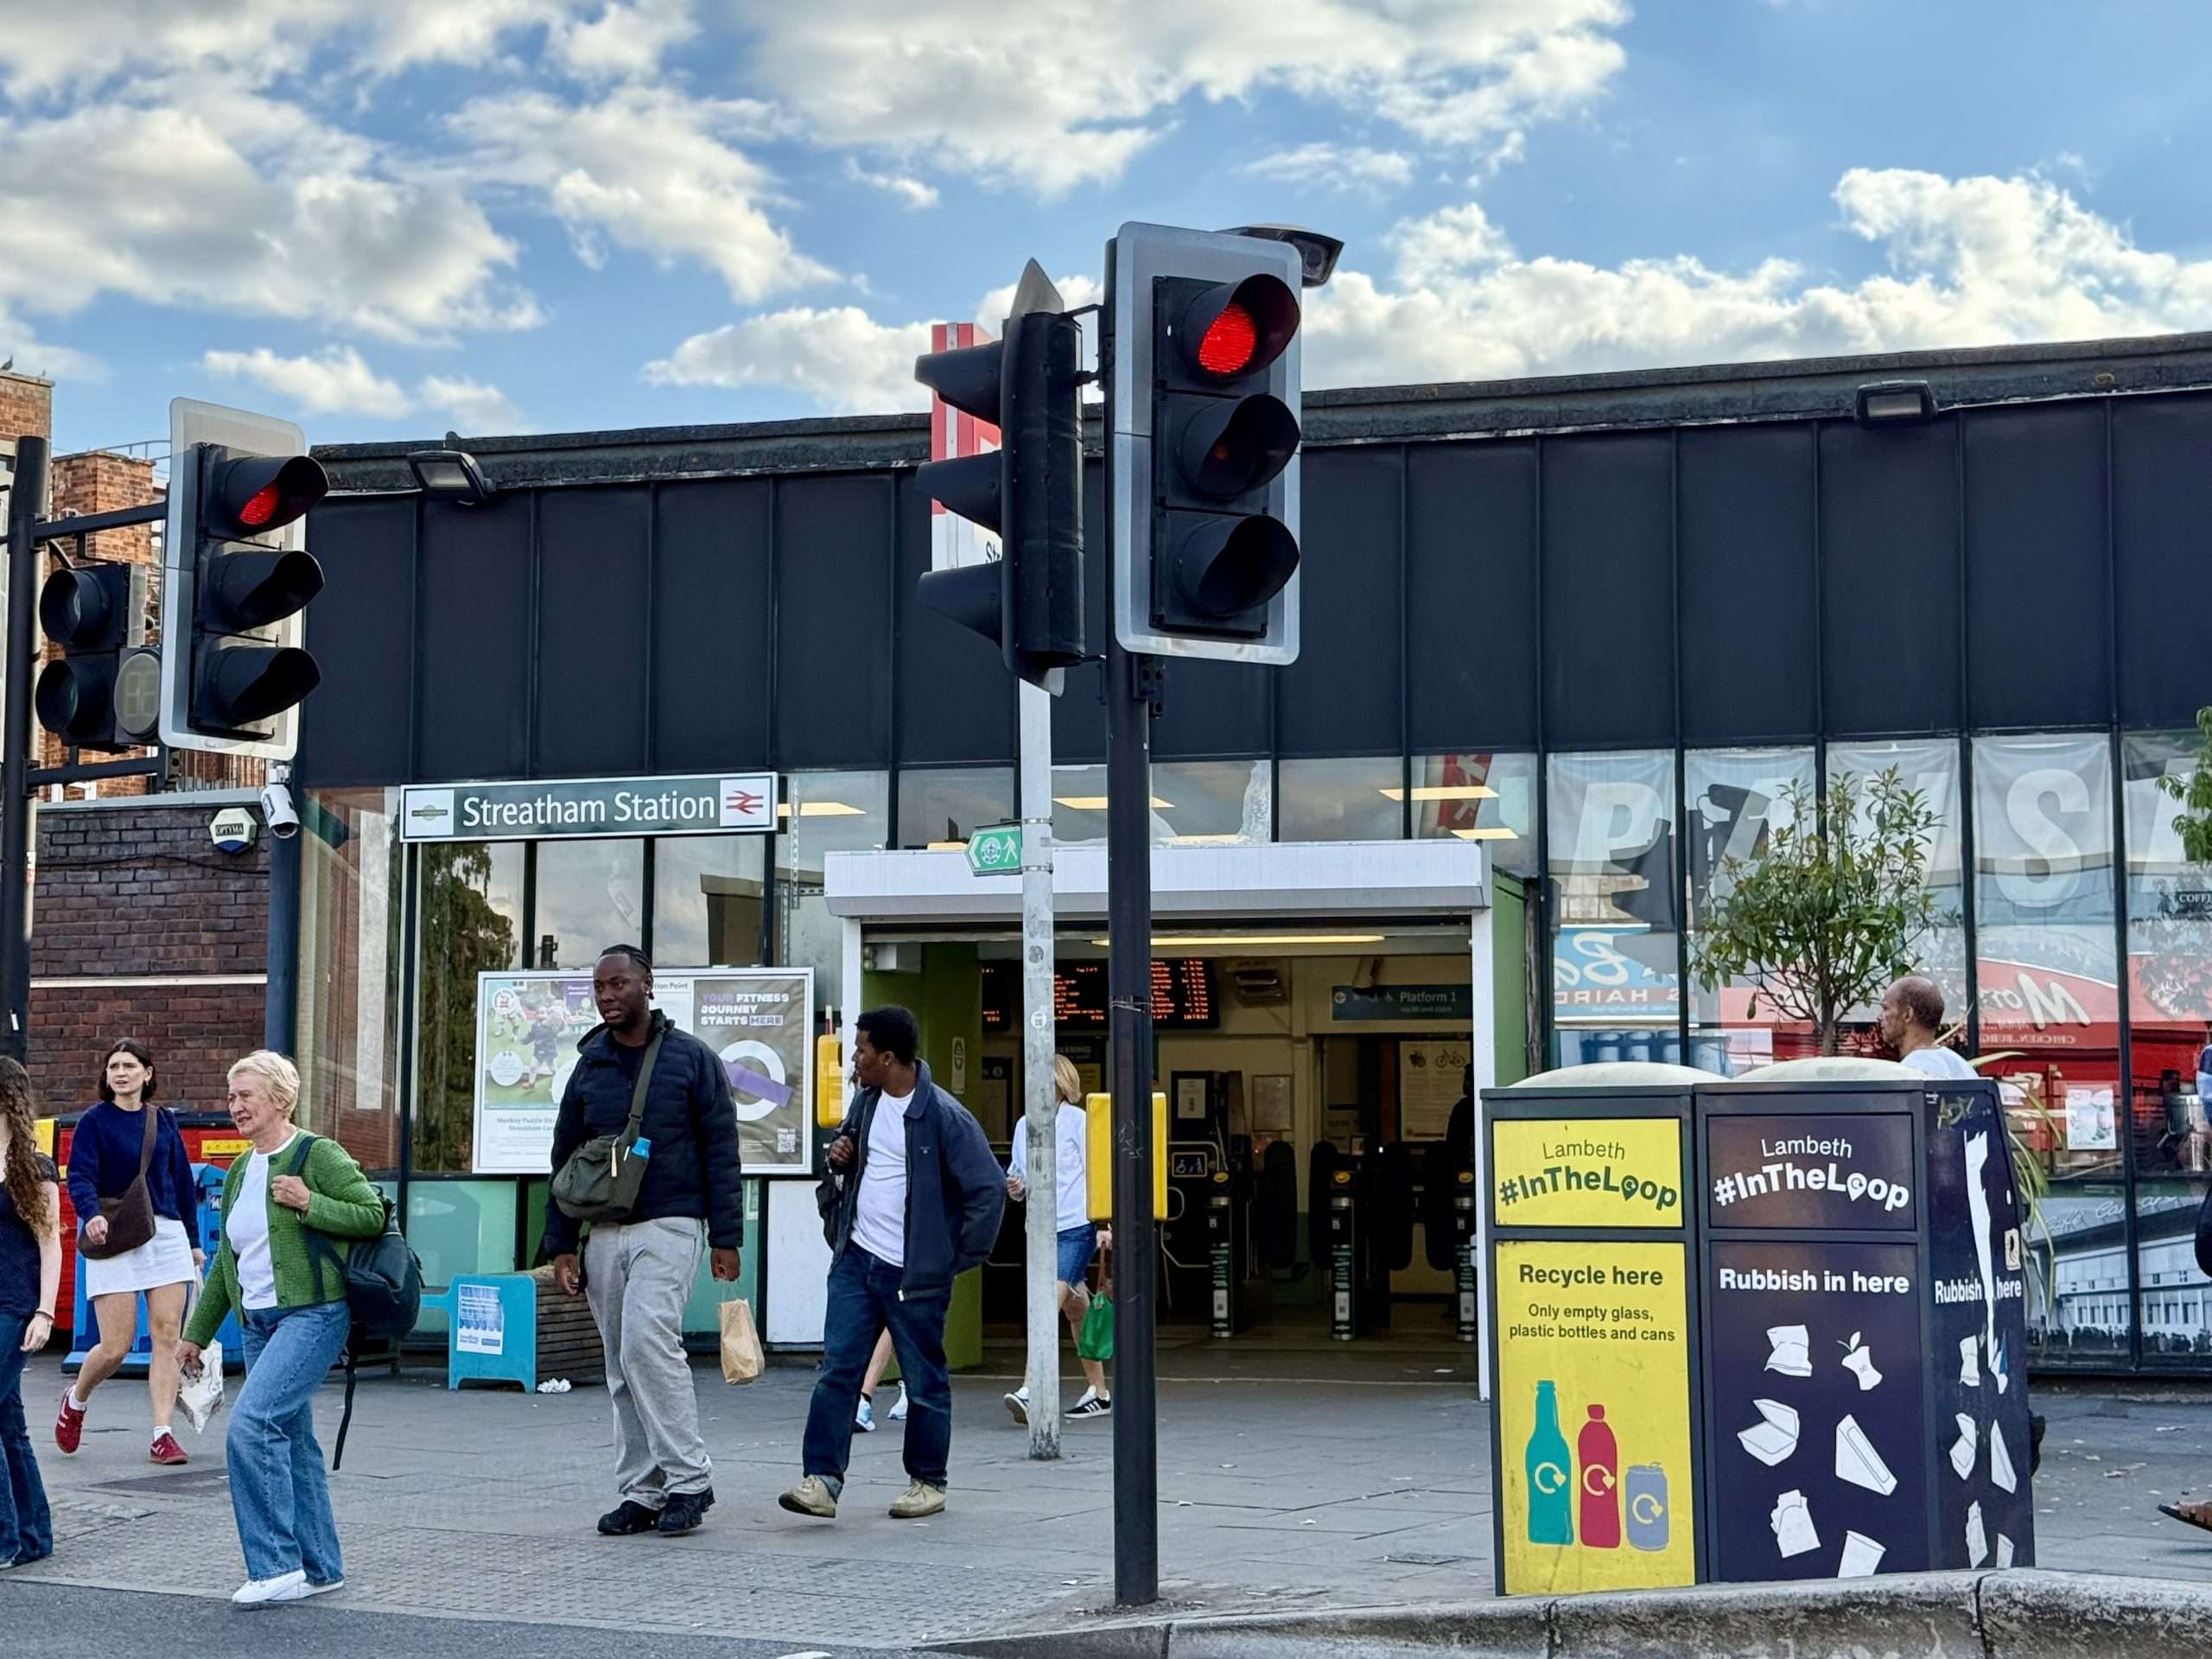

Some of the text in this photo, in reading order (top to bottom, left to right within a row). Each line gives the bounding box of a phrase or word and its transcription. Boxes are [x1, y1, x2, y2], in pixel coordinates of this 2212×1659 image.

[463, 791, 714, 827] Streatham Station
[702, 993, 790, 1003] YOUR FITNESS
[1399, 991, 1457, 1003] Platform 1
[701, 1004, 759, 1014] JOURNEY
[701, 1015, 783, 1026] STARTS HERE
[1543, 1139, 1625, 1160] Lambeth
[1761, 1135, 1853, 1159] Lambeth
[1499, 1165, 1678, 1211] #InTheLoop
[1713, 1161, 1910, 1211] #InTheLoop
[1519, 1264, 1663, 1288] Recycle here
[1719, 1268, 1910, 1294] Rubbish in here
[1935, 1279, 1983, 1304] Rubbish
[1995, 1275, 2022, 1298] here
[1528, 1303, 1654, 1322] Only empty glass,
[1510, 1324, 1675, 1341] plastic bottles and cans
